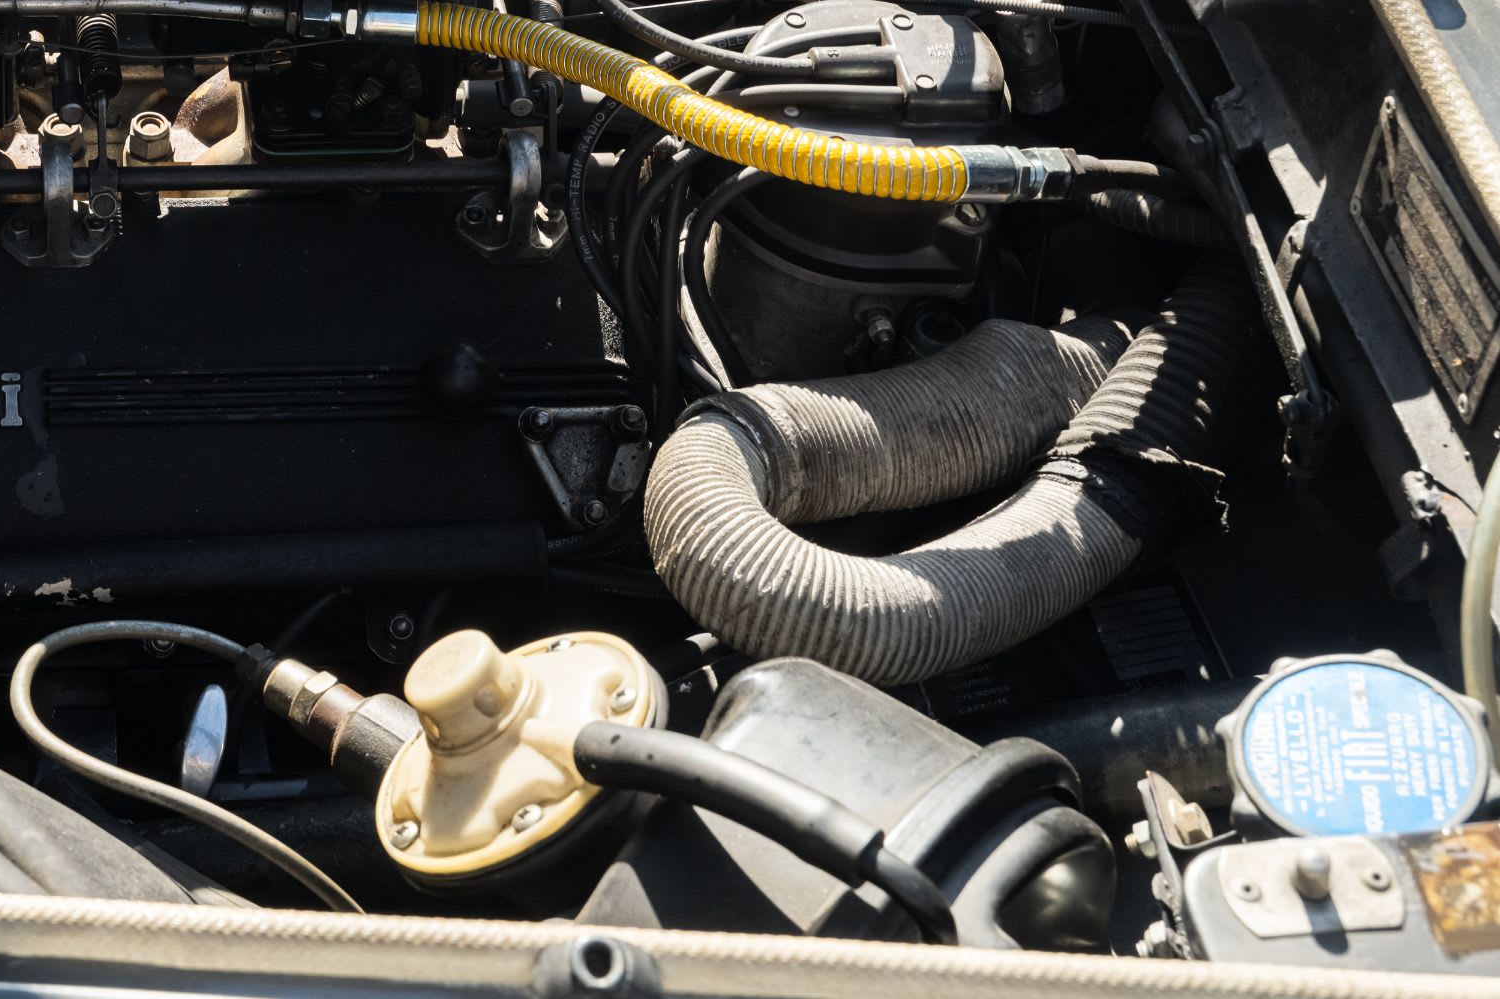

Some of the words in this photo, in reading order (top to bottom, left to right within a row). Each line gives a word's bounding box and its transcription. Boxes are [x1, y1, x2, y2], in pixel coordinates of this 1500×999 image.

[568, 158, 584, 224] HI-TEMP
[578, 111, 606, 153] RADIO
[1348, 671, 1370, 728] SPECALE
[1285, 711, 1311, 797] LIVELLO
[1339, 729, 1391, 781] FIAT
[1386, 712, 1410, 796] AZZURRO
